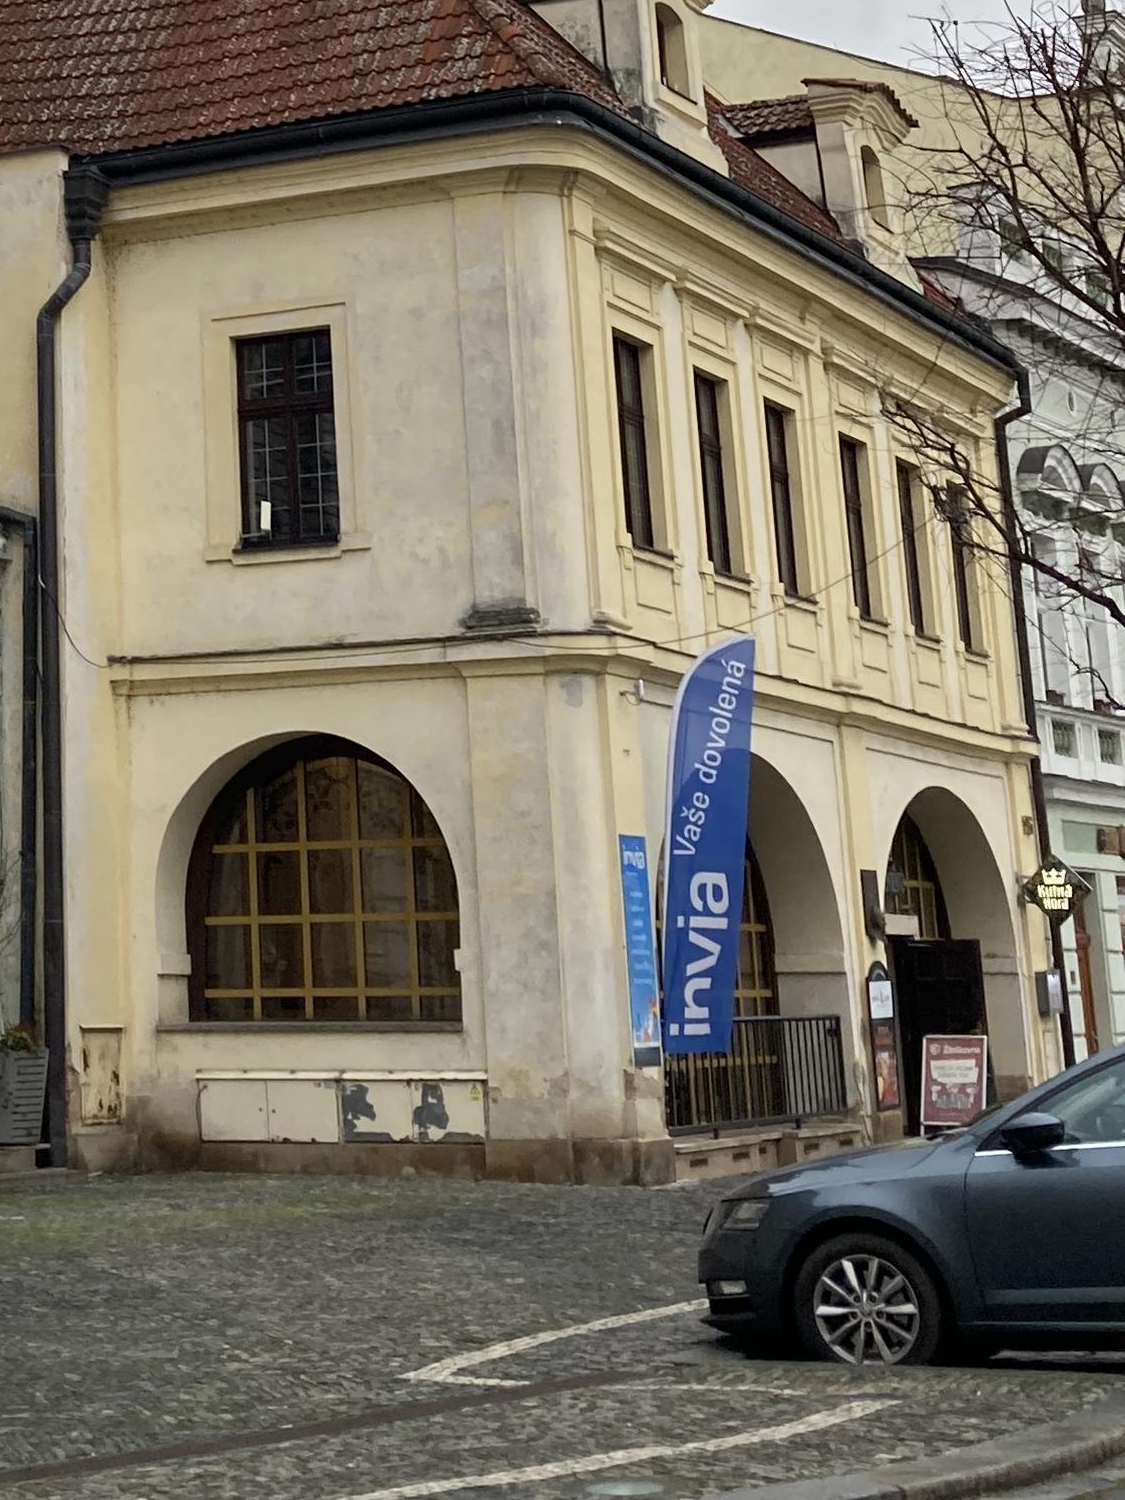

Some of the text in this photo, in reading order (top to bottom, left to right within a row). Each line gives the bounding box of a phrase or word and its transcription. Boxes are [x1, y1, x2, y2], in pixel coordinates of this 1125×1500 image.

[673, 658, 747, 856] Vaše dovolená
[622, 844, 645, 870] invia
[669, 871, 730, 1036] invia
